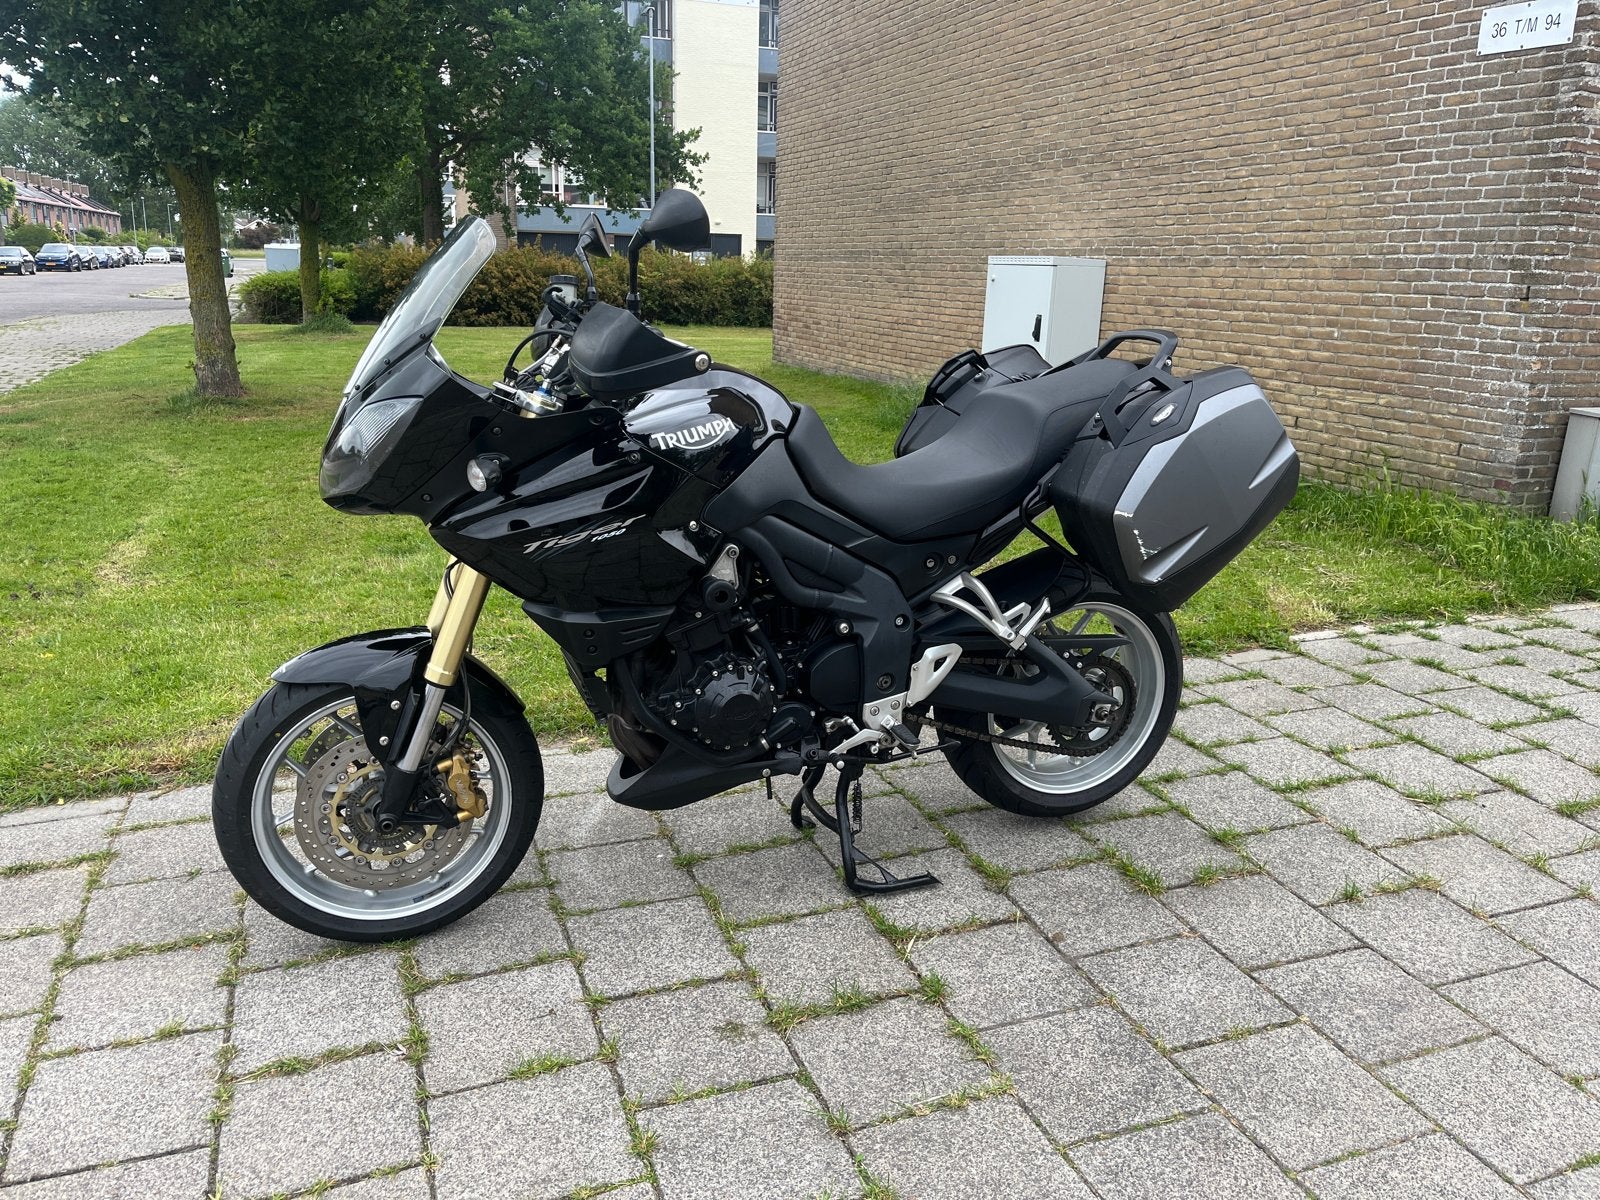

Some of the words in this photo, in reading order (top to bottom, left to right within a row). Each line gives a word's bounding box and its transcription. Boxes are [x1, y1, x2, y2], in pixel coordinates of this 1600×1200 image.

[1491, 22, 1507, 38] 36
[1515, 17, 1538, 34] T/M
[1545, 13, 1561, 30] 94
[651, 417, 736, 450] TRIUMPH
[590, 528, 627, 543] 1050
